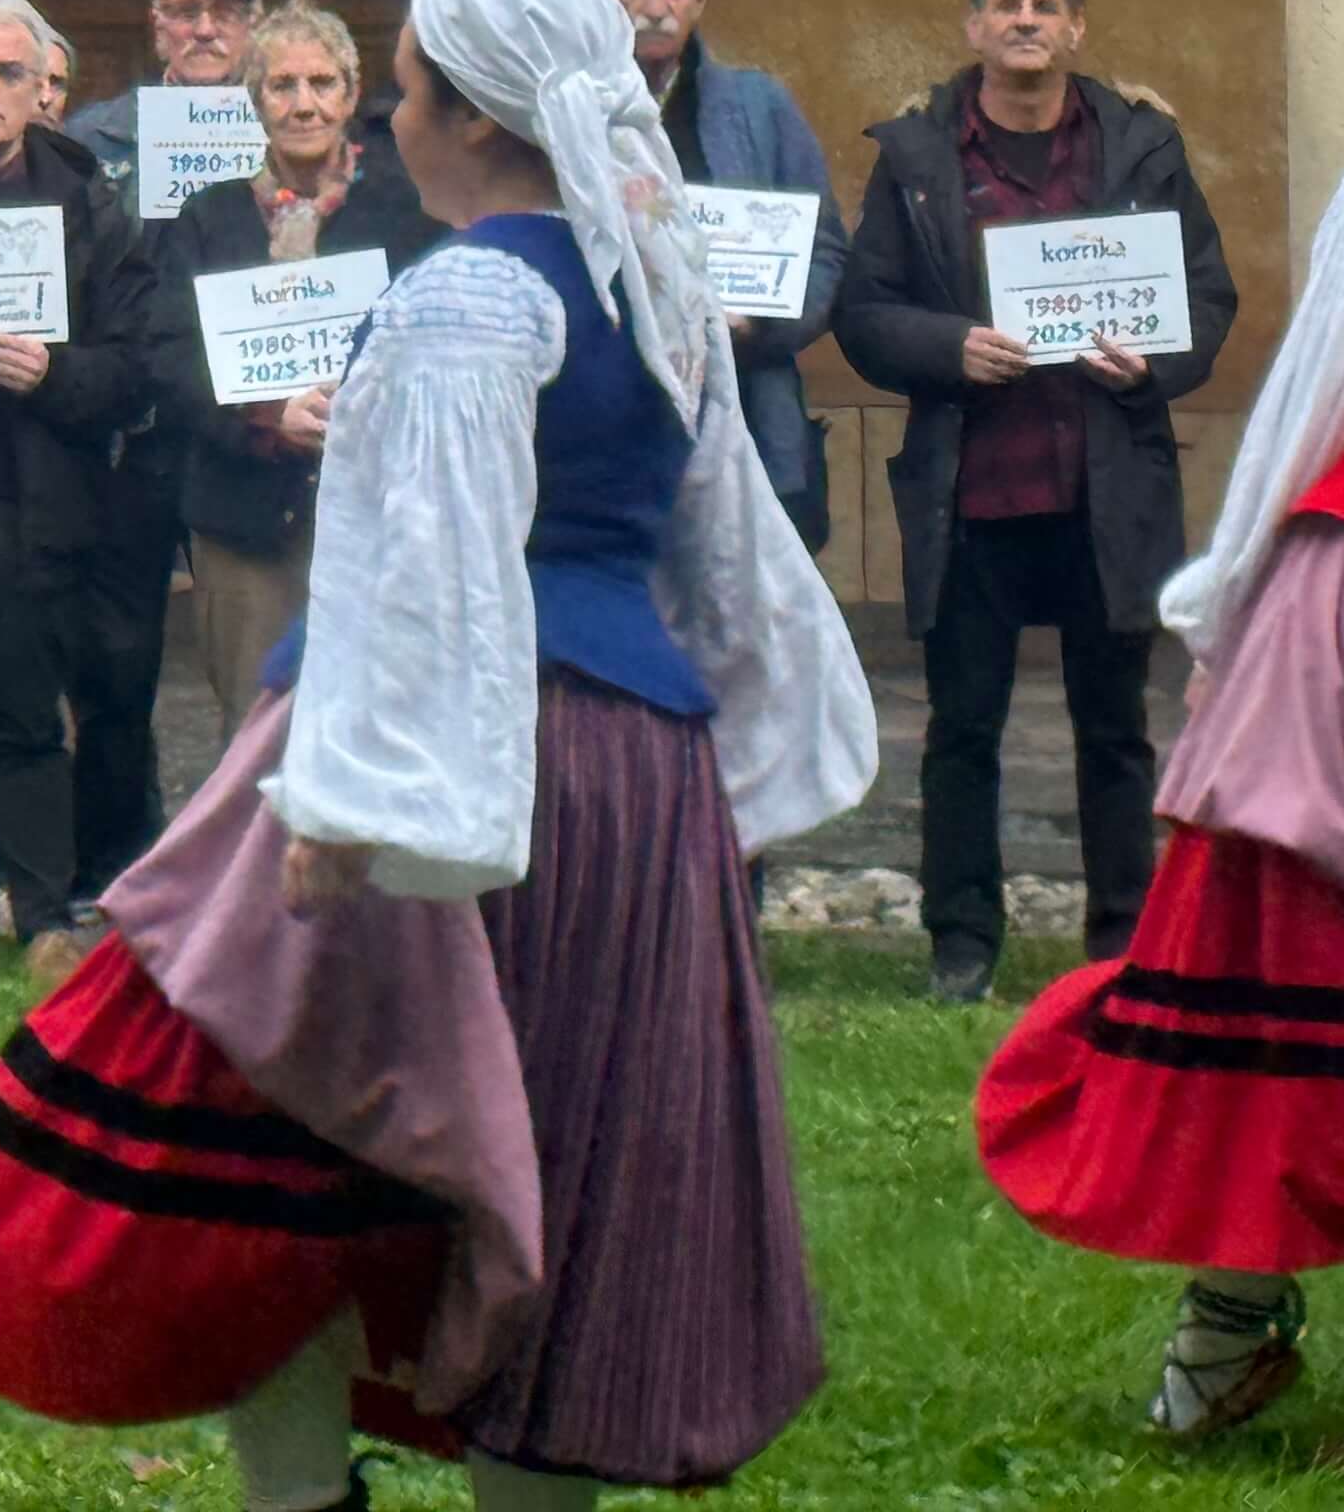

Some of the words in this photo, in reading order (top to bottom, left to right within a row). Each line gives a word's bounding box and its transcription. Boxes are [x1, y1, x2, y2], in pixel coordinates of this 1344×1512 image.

[188, 100, 258, 124] korrik
[168, 153, 263, 173] 1980-11-
[1040, 235, 1127, 263] korrika
[251, 274, 336, 305] korrika
[1024, 286, 1157, 319] 1980-11-29
[237, 323, 356, 359] 1980-11-2
[1026, 313, 1160, 345] 2025-11-29
[240, 354, 345, 385] 2025-11-
